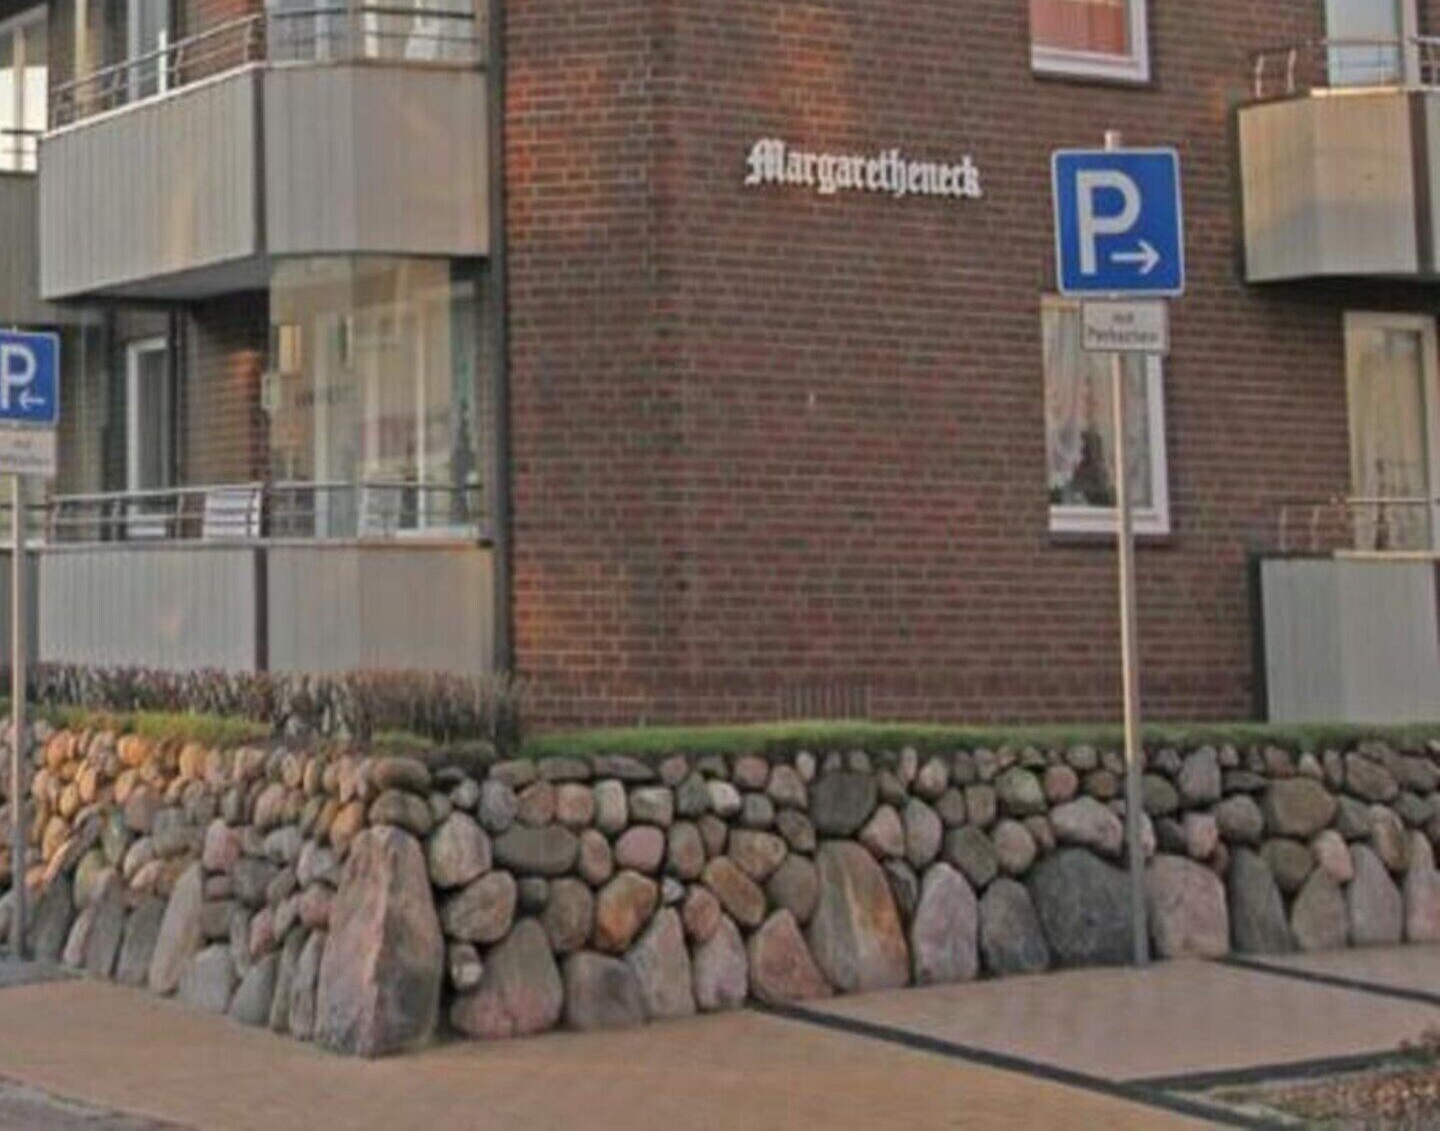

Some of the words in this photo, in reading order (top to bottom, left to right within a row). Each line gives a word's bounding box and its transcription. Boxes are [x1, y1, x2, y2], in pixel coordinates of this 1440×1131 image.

[745, 138, 982, 197] Margaretheneck
[1076, 170, 1141, 275] P
[0, 343, 36, 410] P
